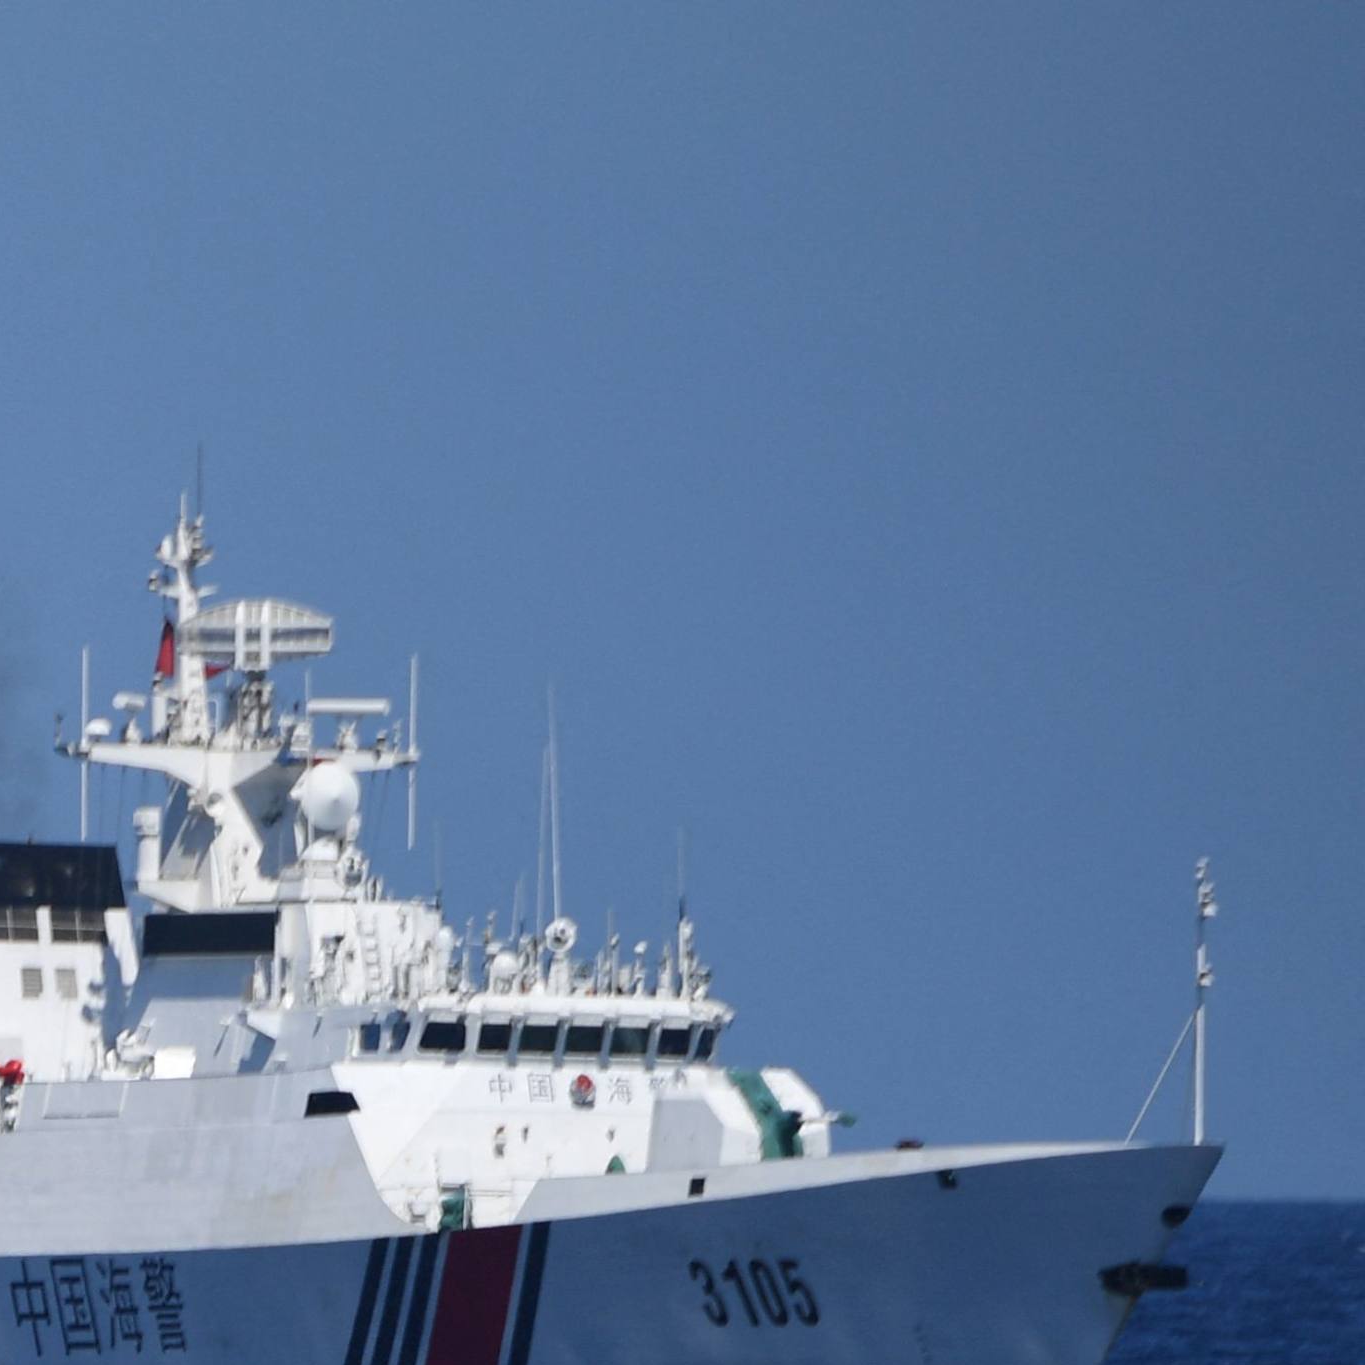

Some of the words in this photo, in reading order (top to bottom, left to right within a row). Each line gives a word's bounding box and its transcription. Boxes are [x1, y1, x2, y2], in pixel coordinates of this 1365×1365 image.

[10, 1257, 187, 1357] 中国海警
[689, 1257, 819, 1327] 3105
